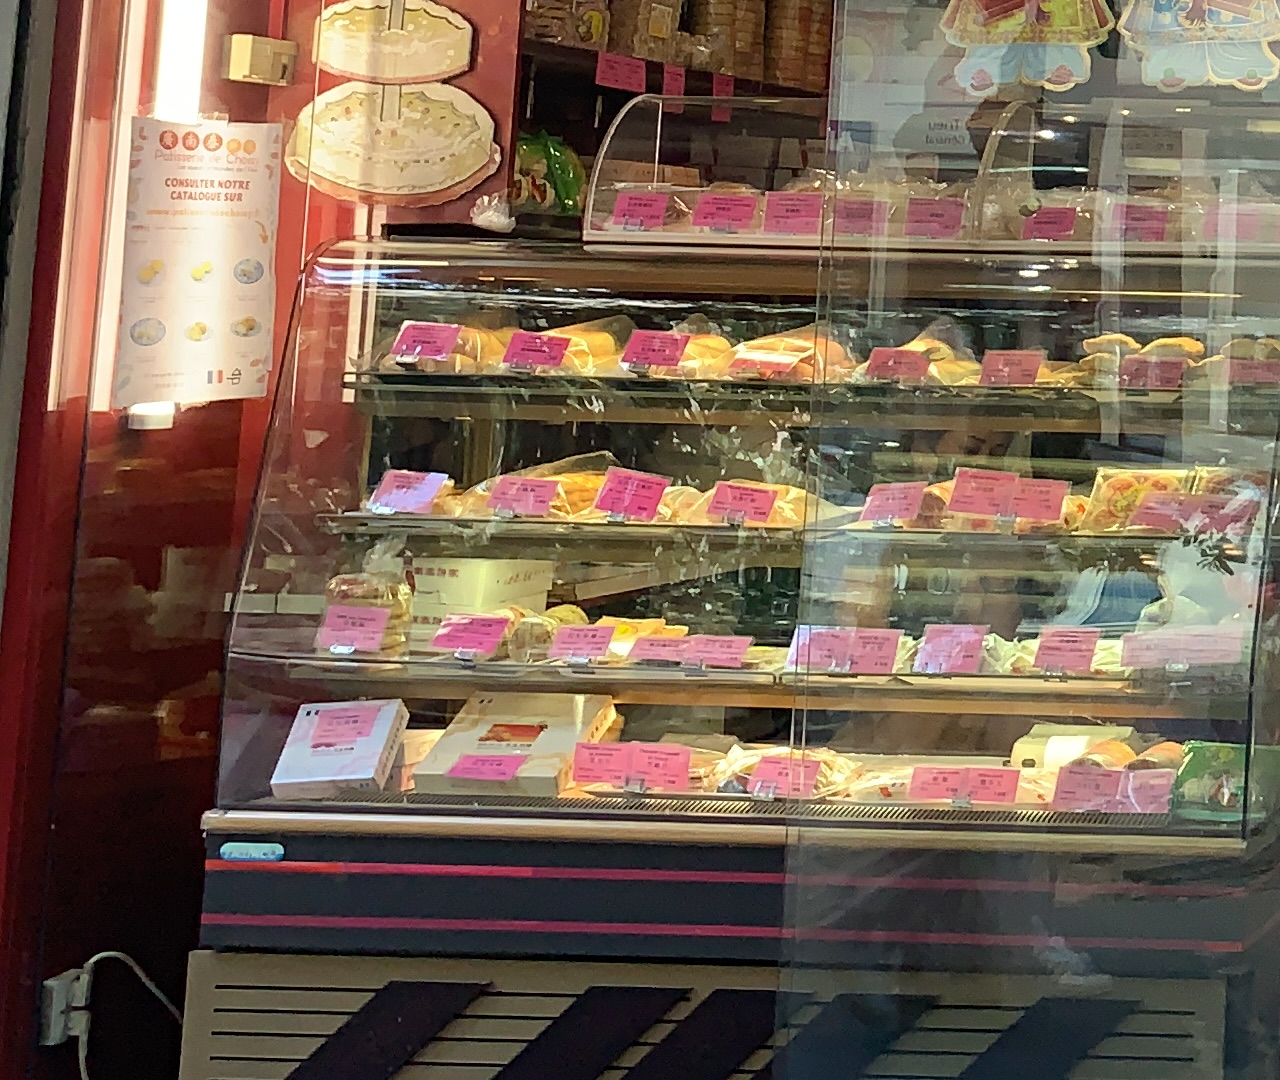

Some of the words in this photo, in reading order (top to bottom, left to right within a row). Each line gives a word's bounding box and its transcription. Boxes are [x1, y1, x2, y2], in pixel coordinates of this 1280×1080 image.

[164, 178, 215, 189] CONSULTER
[218, 179, 251, 190] NOTRE
[170, 190, 222, 201] CATALOGUE
[224, 192, 244, 202] SUR
